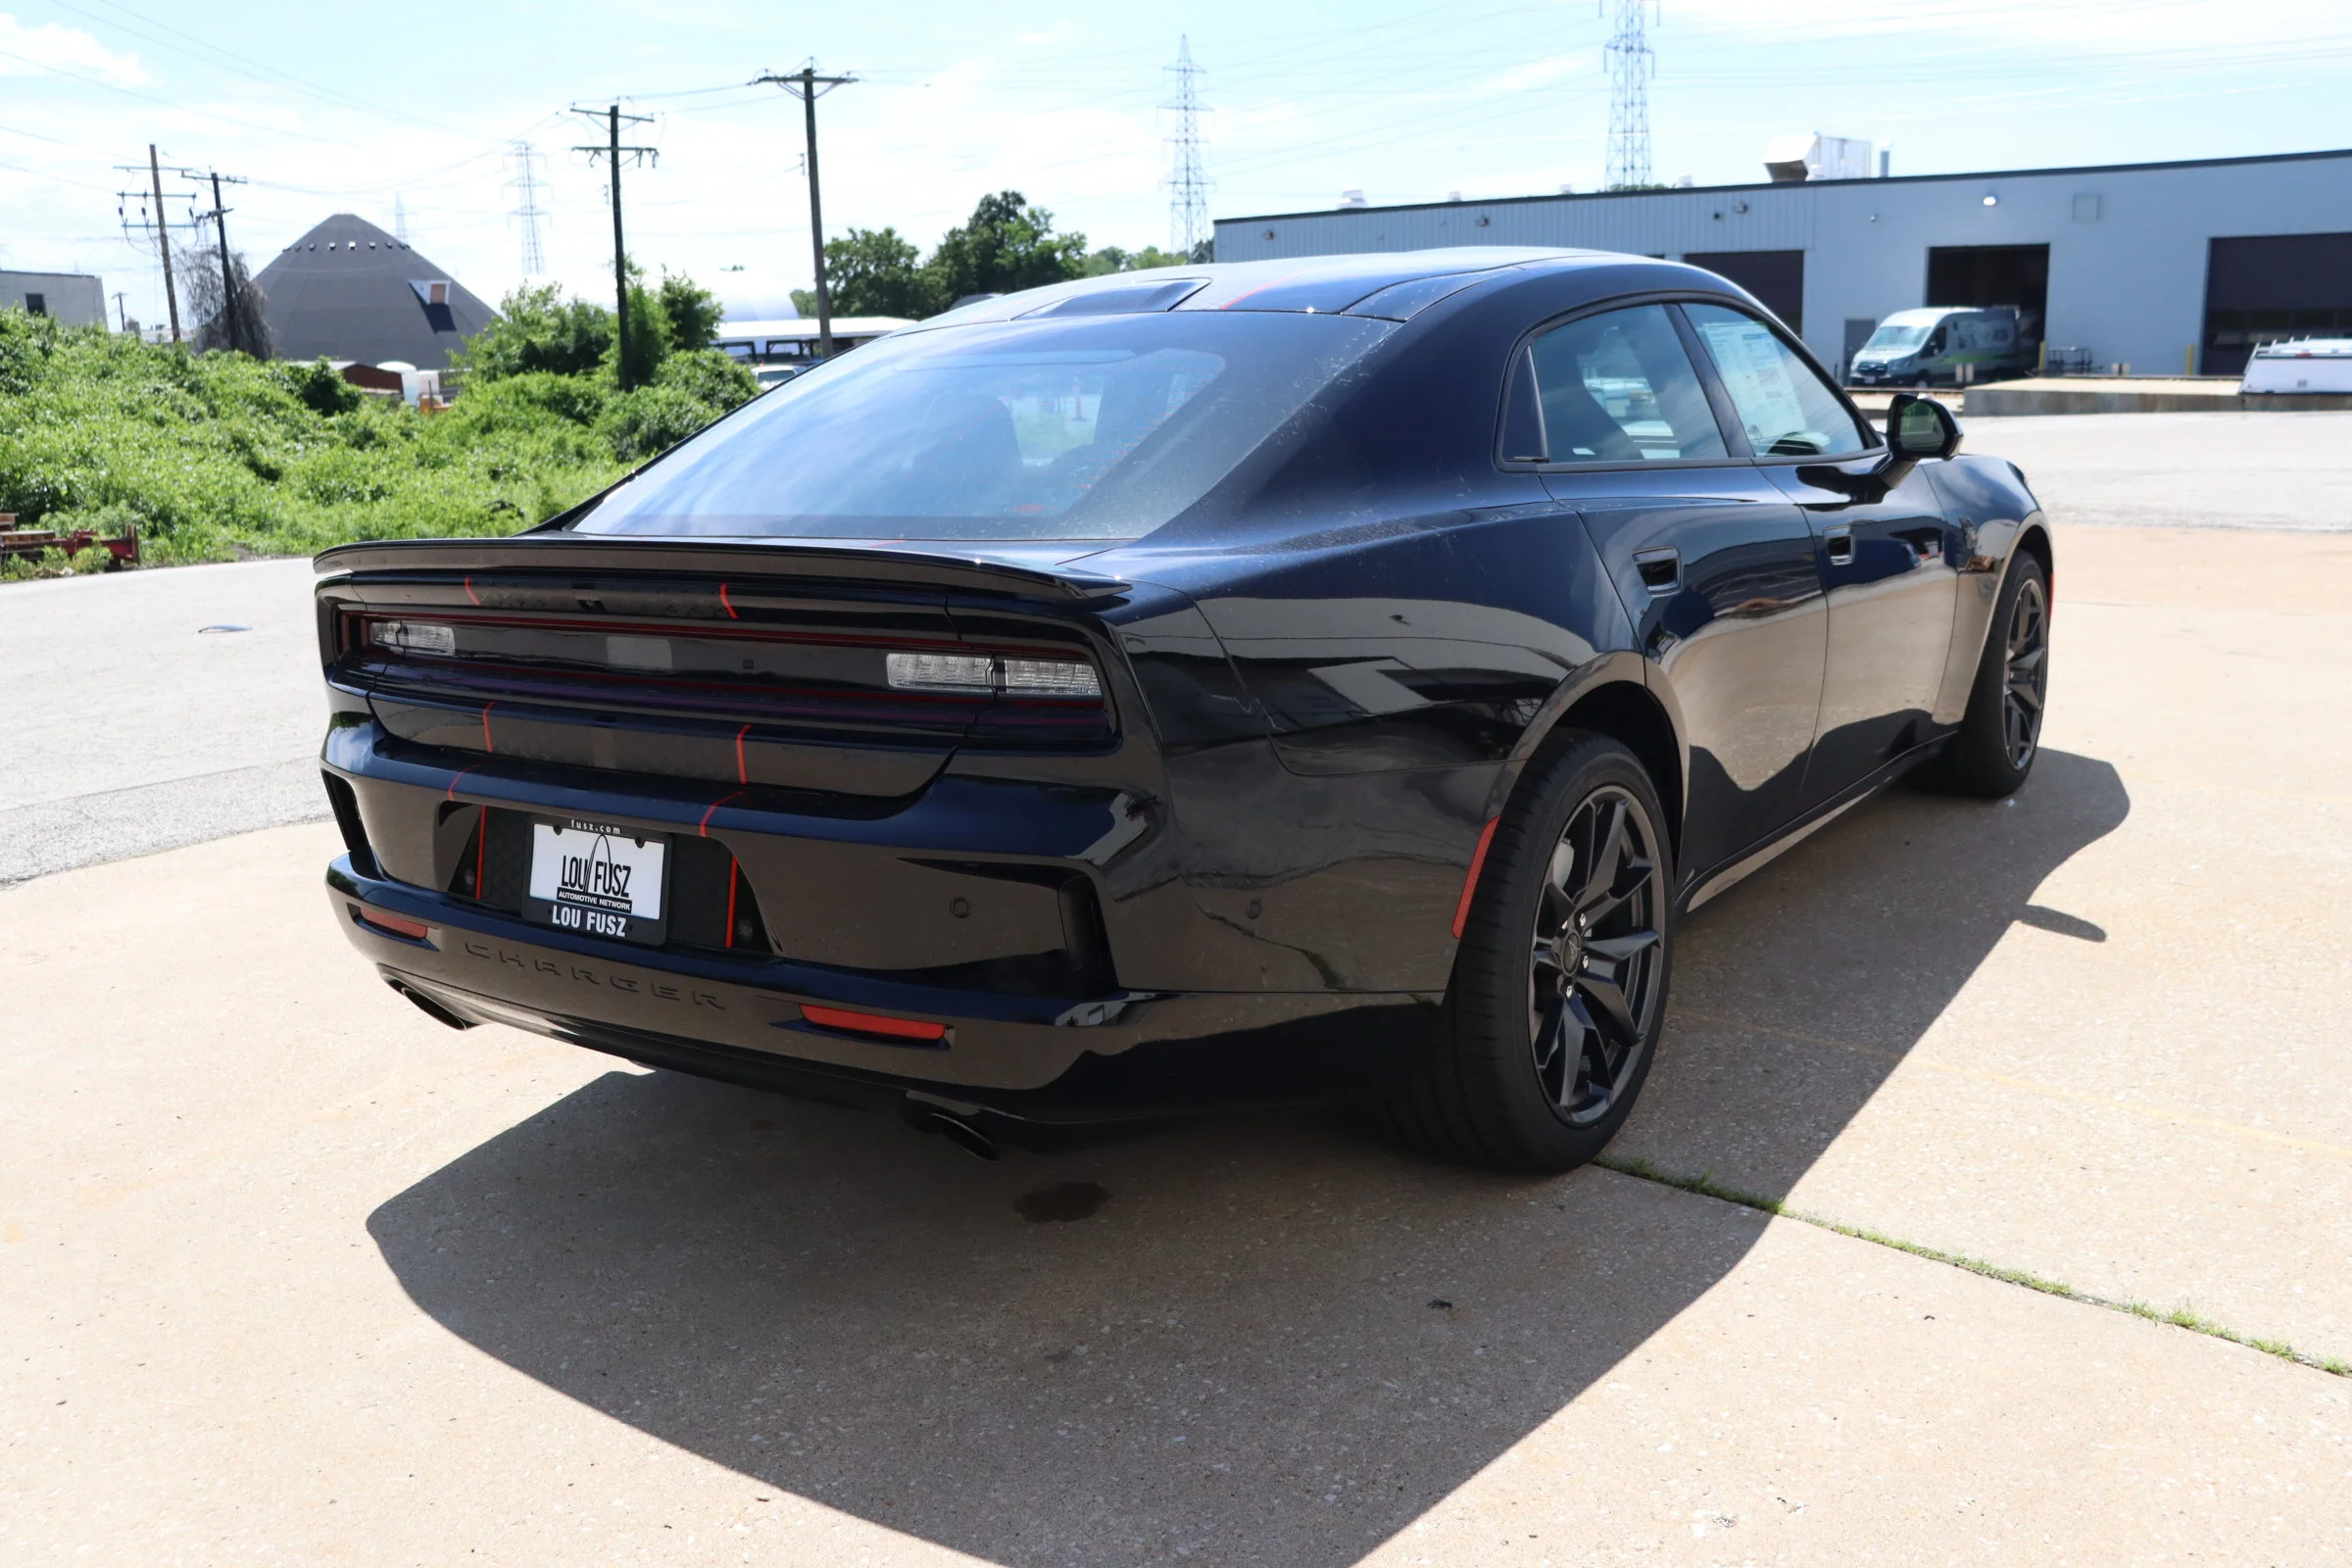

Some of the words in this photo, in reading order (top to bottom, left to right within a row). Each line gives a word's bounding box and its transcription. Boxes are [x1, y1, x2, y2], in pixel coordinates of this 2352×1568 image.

[571, 819, 620, 834] fusz.com
[562, 855, 588, 889] LOU
[594, 860, 631, 898] FUSZ
[559, 891, 598, 905] AUTOMOTIVE
[599, 899, 631, 910] NETWORK
[552, 905, 581, 928] LOU
[587, 910, 627, 937] FUSZ
[465, 942, 725, 1010] CHARGER
